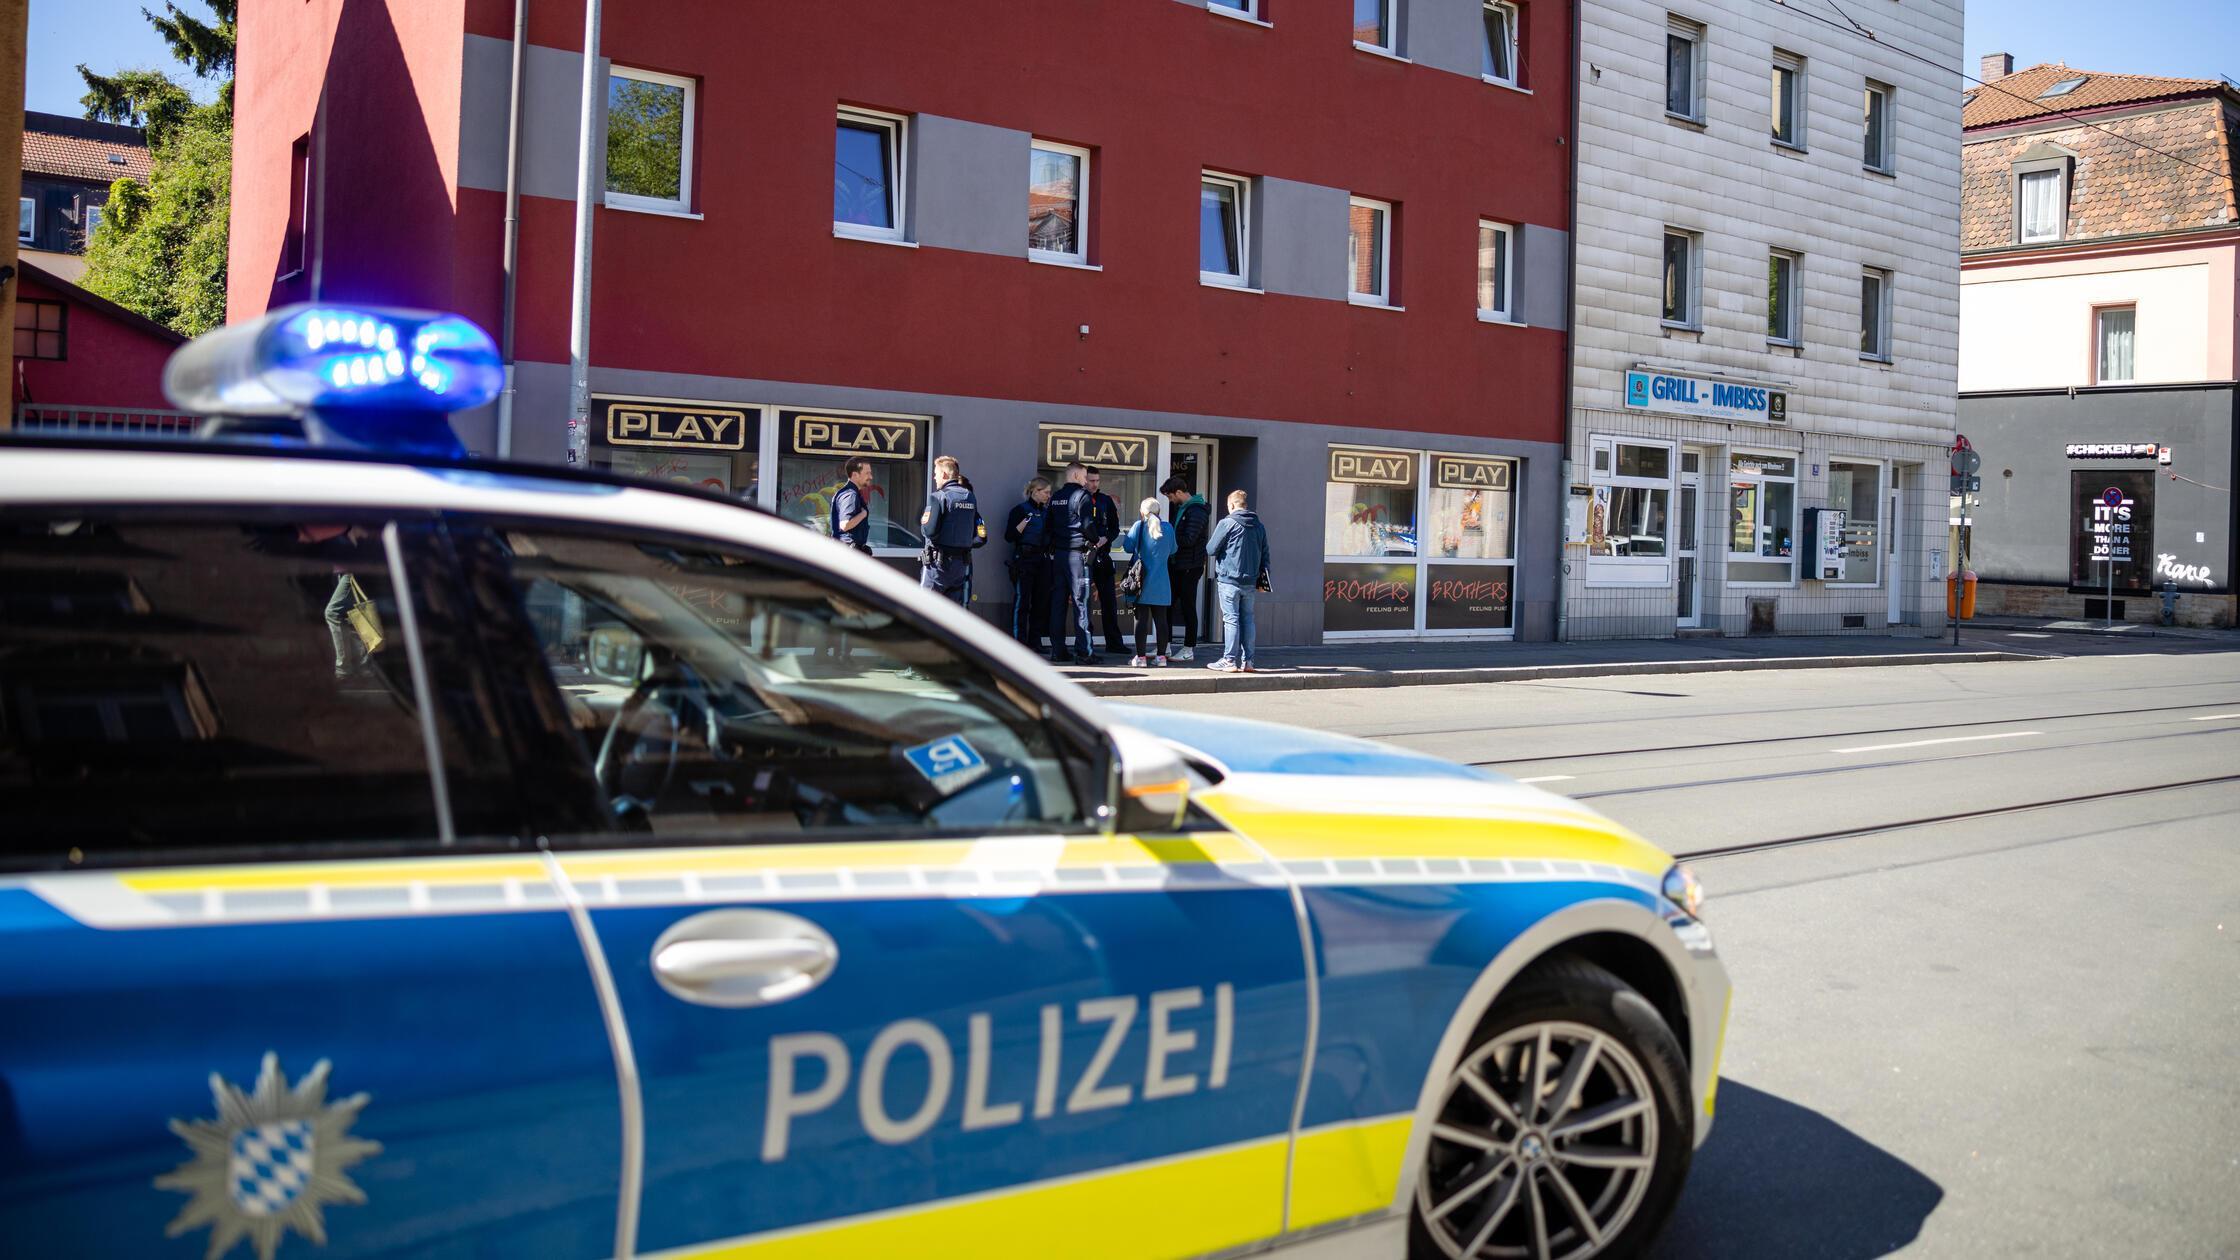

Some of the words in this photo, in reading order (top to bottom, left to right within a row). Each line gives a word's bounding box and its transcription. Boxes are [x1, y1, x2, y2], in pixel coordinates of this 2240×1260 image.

[1652, 376, 1699, 404] GRILL
[1712, 383, 1767, 411] IMBISS
[619, 412, 733, 442] PLAY
[804, 422, 905, 451] PLAY
[1056, 439, 1139, 464] PLAY
[2066, 444, 2132, 454] #CHICKEN
[1338, 456, 1403, 479] PLAY
[1444, 463, 1503, 485] PLAY
[2095, 506, 2131, 521] IT'S
[2094, 523, 2130, 533] MORE
[2122, 536, 2130, 544] A
[1324, 579, 1409, 603] BROTHERS
[1432, 580, 1508, 603] BROTHERS
[761, 982, 1235, 1163] POLIZEI
